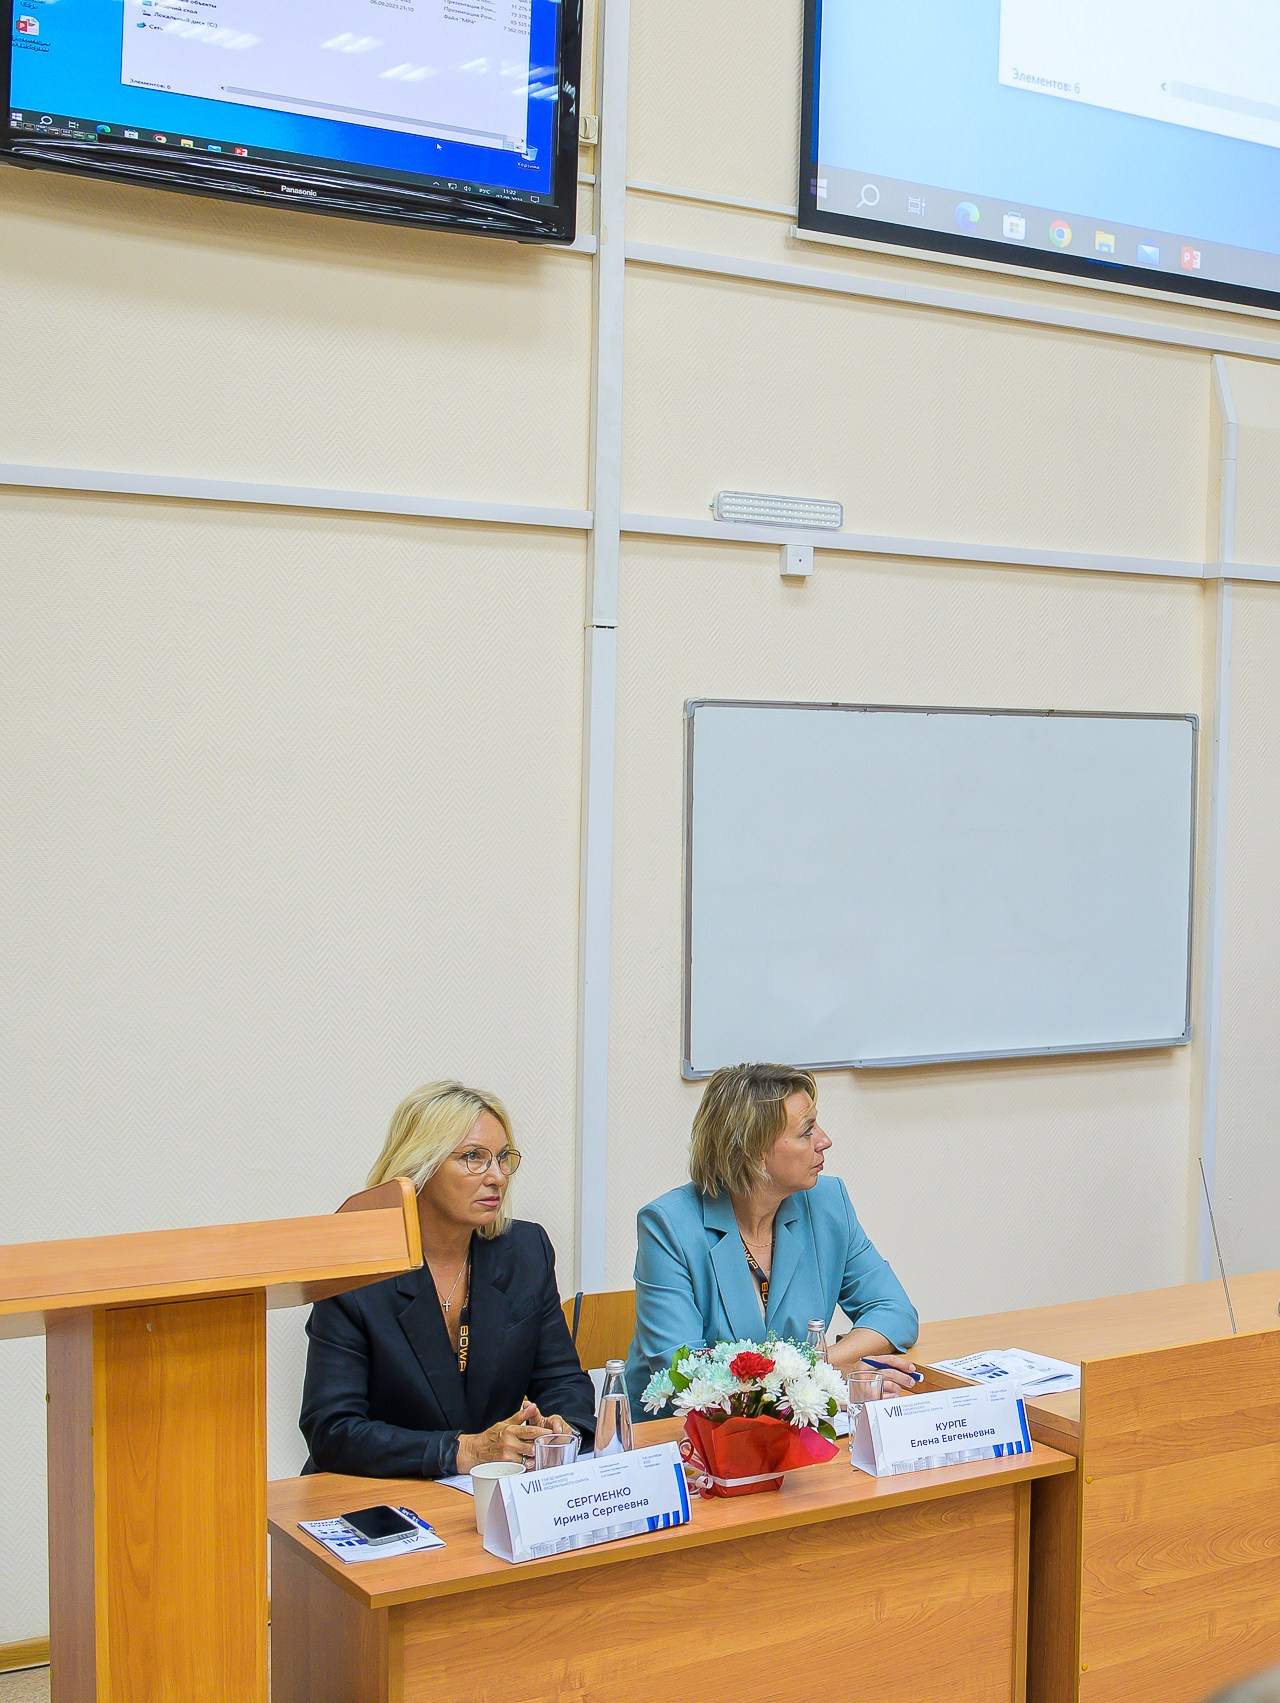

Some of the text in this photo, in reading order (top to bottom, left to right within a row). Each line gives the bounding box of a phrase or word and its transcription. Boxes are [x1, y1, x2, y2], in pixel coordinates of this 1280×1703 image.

[1012, 68, 1081, 94] Элементов: 6
[281, 185, 317, 197] Panasonic
[884, 1405, 903, 1418] VIII
[935, 1418, 968, 1432] КУРПЕ
[910, 1428, 996, 1449] Елена Евгеньевна
[521, 1479, 543, 1495] VIII
[567, 1487, 632, 1509] СЕРГИЕНКО
[554, 1498, 649, 1527] Ирина Сергеевна
